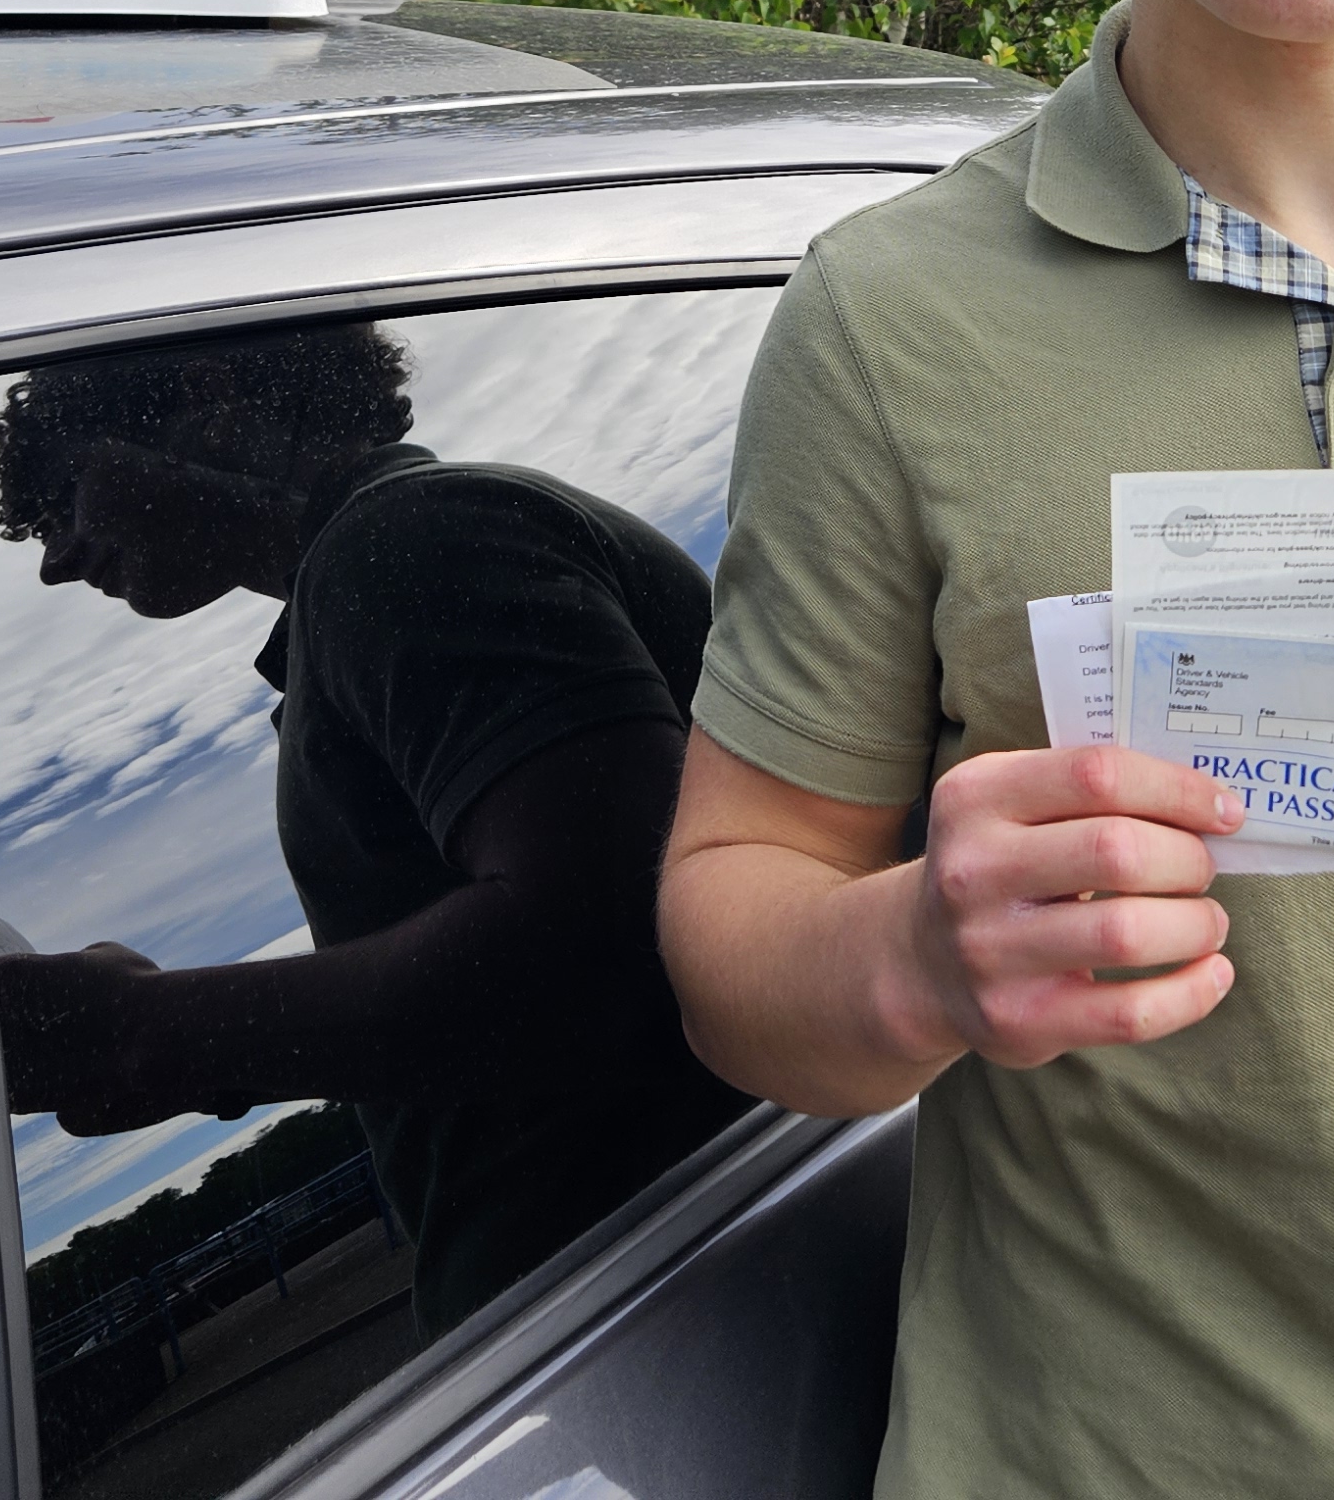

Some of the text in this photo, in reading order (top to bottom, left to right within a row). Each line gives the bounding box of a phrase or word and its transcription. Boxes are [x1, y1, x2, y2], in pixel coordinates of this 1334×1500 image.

[1071, 592, 1113, 605] Certific
[1079, 642, 1111, 654] Driver
[1082, 666, 1107, 676] Date
[1176, 668, 1204, 678] Driver
[1216, 670, 1249, 680] Vehicle
[1175, 678, 1224, 689] Standards
[1174, 687, 1211, 699] Agency
[1168, 703, 1193, 711] Issue
[1259, 708, 1276, 717] Fee
